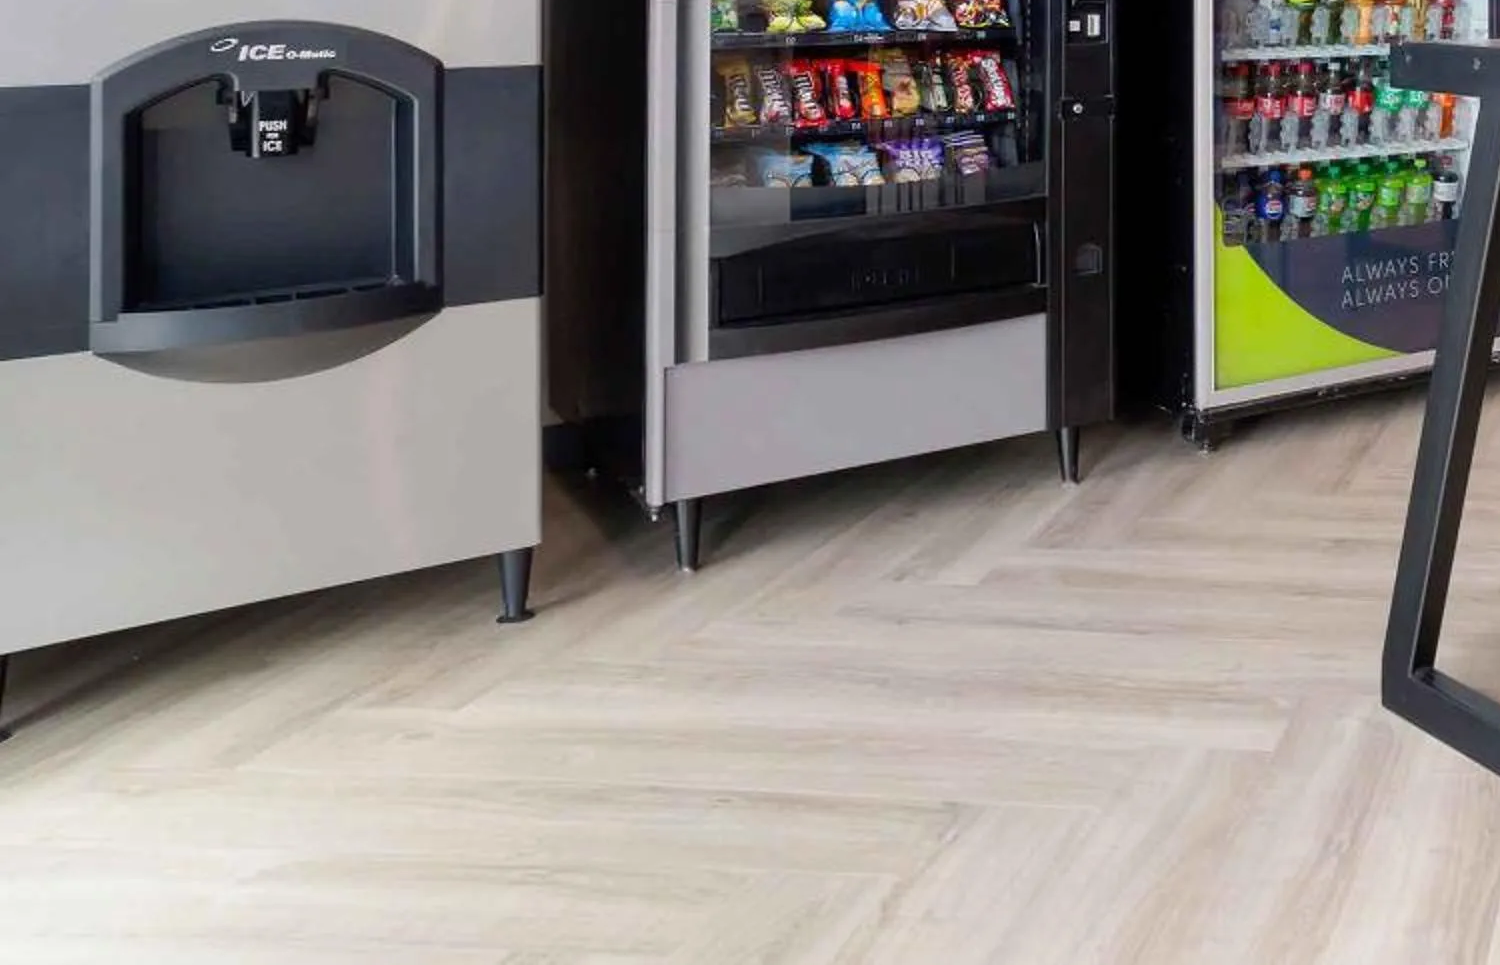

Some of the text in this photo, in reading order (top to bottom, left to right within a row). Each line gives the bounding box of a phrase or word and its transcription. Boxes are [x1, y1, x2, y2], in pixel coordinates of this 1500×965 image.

[238, 44, 287, 62] ICE
[259, 120, 288, 132] PUSH
[262, 141, 282, 152] ICE
[1341, 251, 1455, 284] ALWAYS FR
[1341, 279, 1419, 310] ALWAYS
